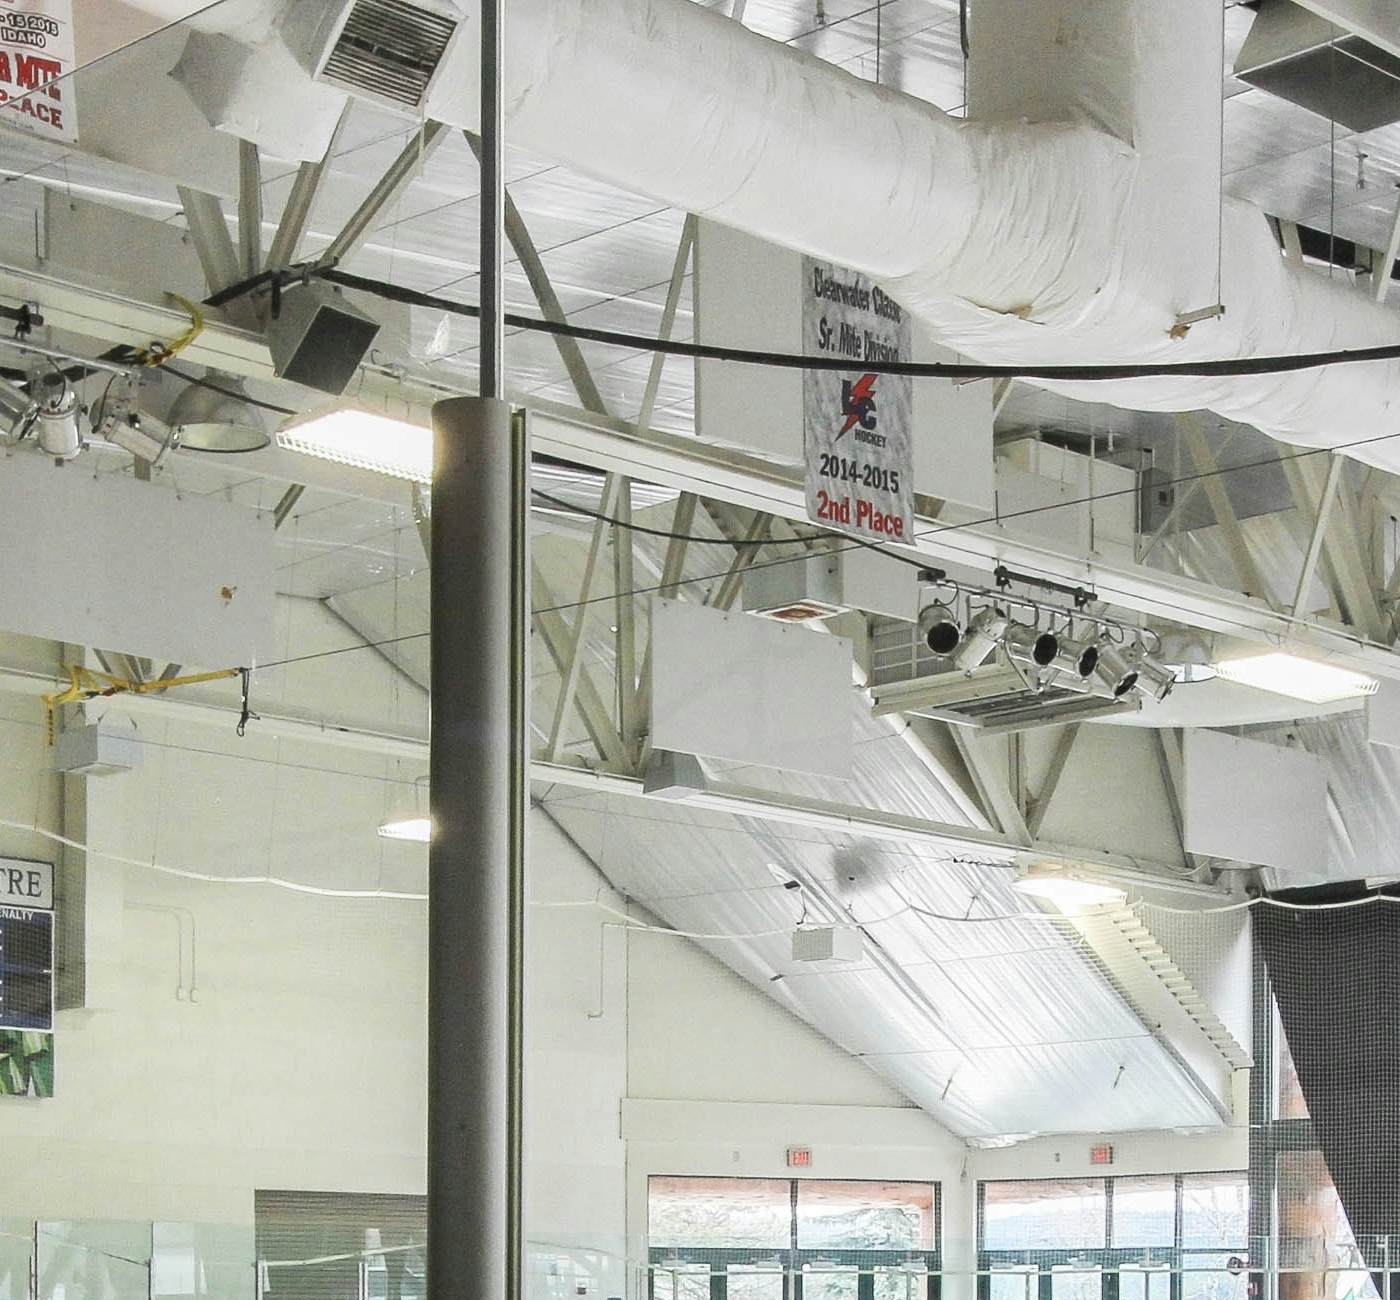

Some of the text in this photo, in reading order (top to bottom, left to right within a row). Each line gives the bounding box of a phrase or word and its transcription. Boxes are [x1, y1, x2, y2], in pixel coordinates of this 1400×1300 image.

[1, 26, 46, 48] IDAHO
[27, 15, 59, 37] 2015
[814, 266, 871, 312] Clearwater
[819, 316, 835, 352] Sr.
[854, 428, 887, 449] HOCKEY
[819, 453, 899, 494] 2014-2015
[816, 489, 904, 537] 2nd Place
[0, 907, 34, 921] NALTY
